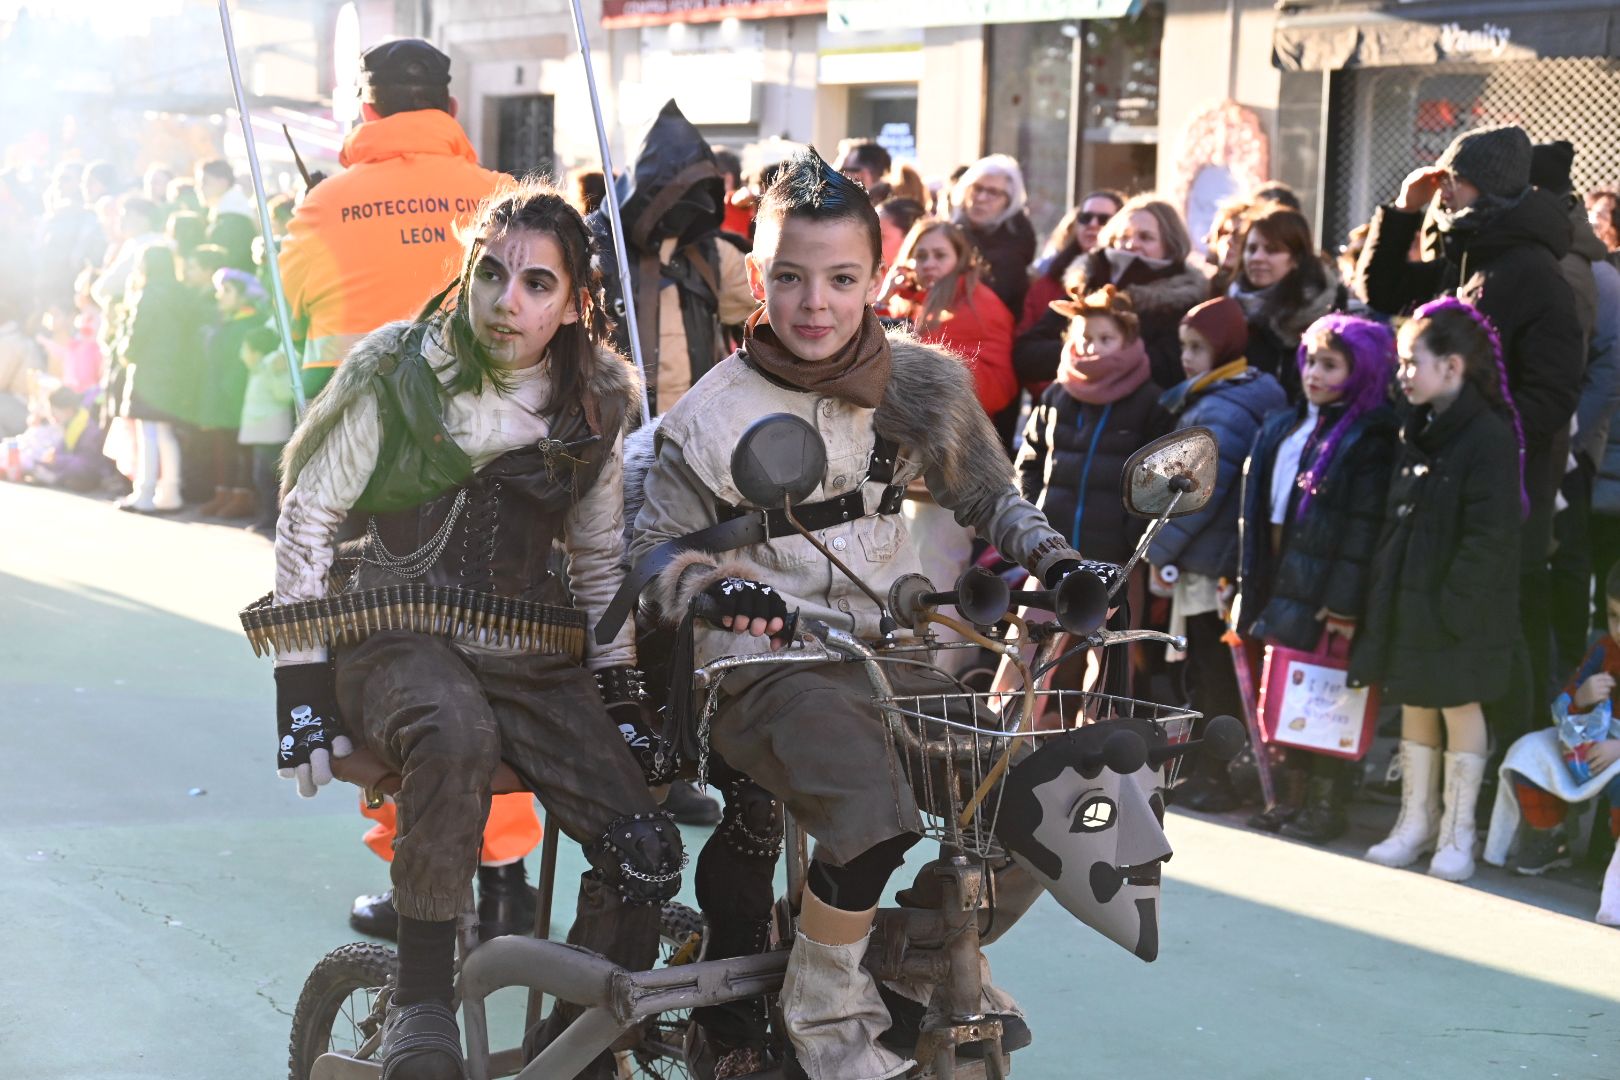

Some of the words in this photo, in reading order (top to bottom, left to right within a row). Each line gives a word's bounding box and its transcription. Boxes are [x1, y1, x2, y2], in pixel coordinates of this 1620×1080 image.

[1441, 22, 1510, 57] Vanity
[455, 198, 489, 212] CIV
[400, 224, 446, 244] LEÓN
